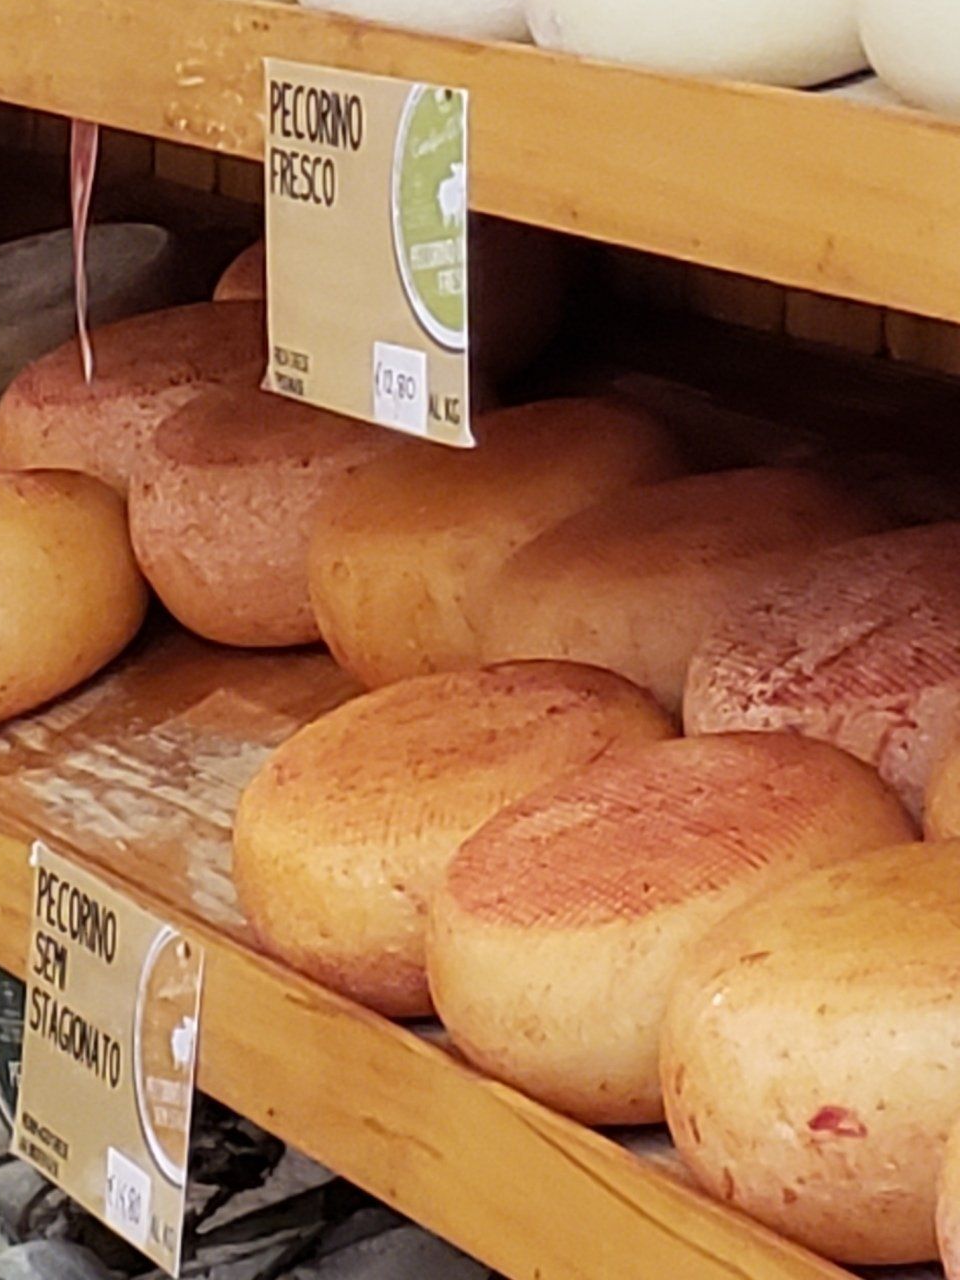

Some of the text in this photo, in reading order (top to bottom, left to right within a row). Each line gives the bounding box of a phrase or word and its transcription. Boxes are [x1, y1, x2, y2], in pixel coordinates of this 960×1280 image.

[270, 79, 363, 152] PECORINO
[270, 146, 335, 208] FRESCO
[36, 866, 117, 964] PECORINO
[33, 930, 68, 992] SEMI
[29, 986, 121, 1088] STAGIONATO
